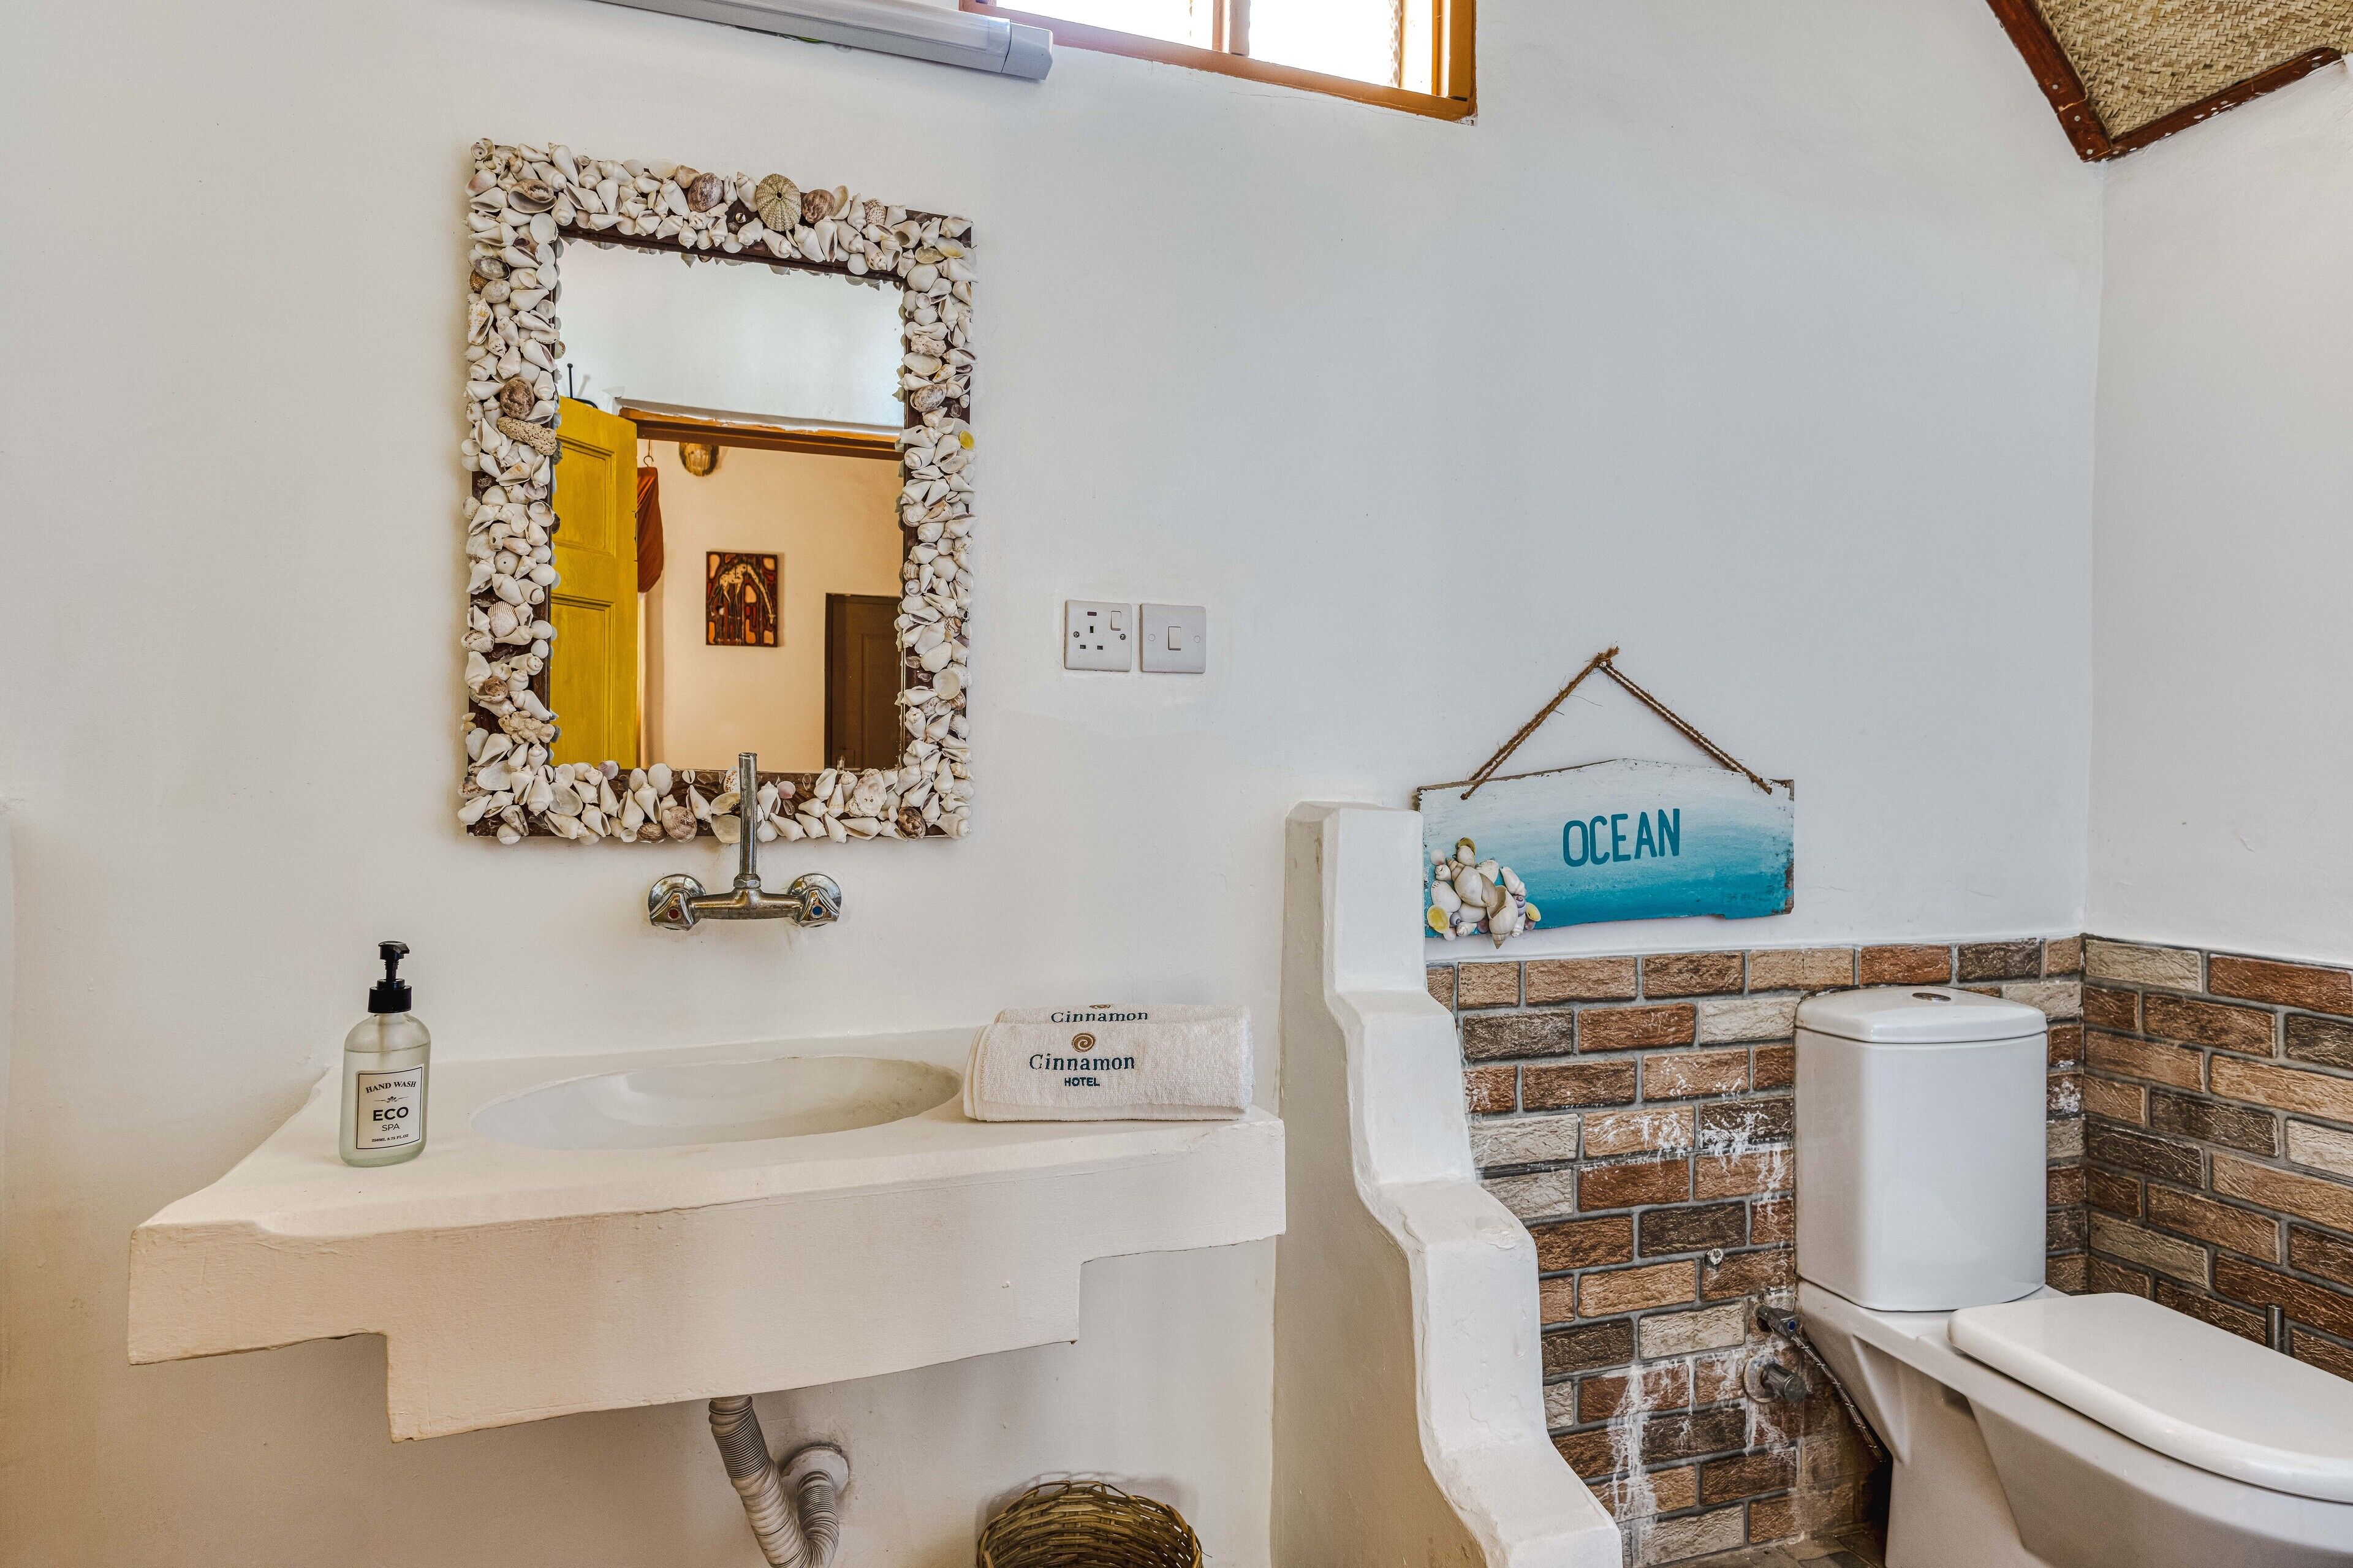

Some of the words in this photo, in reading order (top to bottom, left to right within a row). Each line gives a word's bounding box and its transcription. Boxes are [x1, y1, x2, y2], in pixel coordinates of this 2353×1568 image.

[1563, 808, 1680, 867] OCEAN
[1051, 1010, 1148, 1023] Cinnamon
[1029, 1053, 1135, 1070] Cinnamon
[366, 1083, 391, 1093] HAND
[1064, 1077, 1100, 1087] HOTEL
[373, 1107, 409, 1121] ECO
[382, 1123, 400, 1132] SPA
